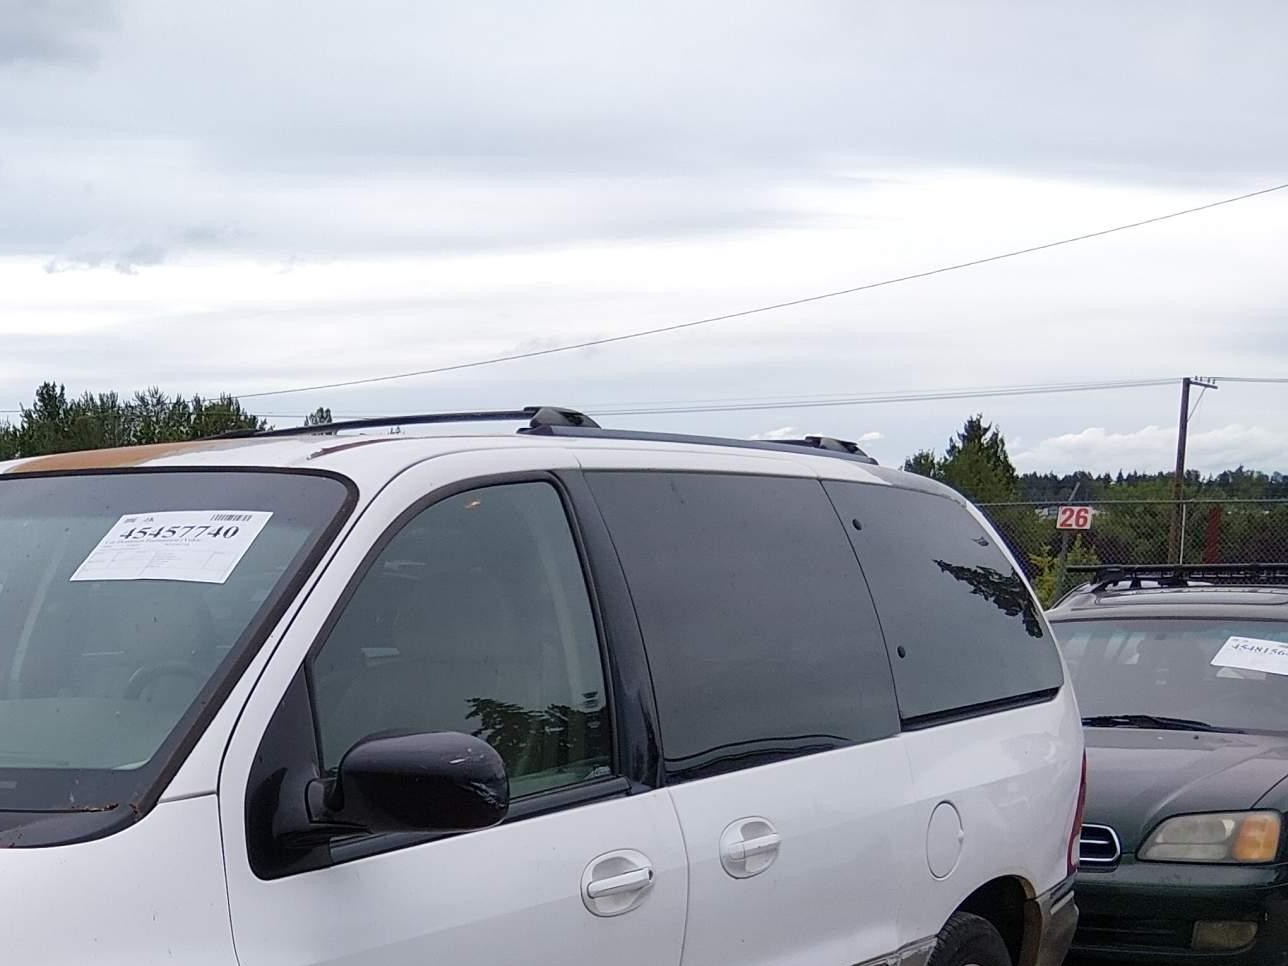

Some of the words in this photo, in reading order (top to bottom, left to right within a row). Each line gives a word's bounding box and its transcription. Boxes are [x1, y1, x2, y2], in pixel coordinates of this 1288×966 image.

[1059, 507, 1089, 528] 26
[121, 525, 240, 539] 45457740
[1232, 644, 1288, 655] 4548156
